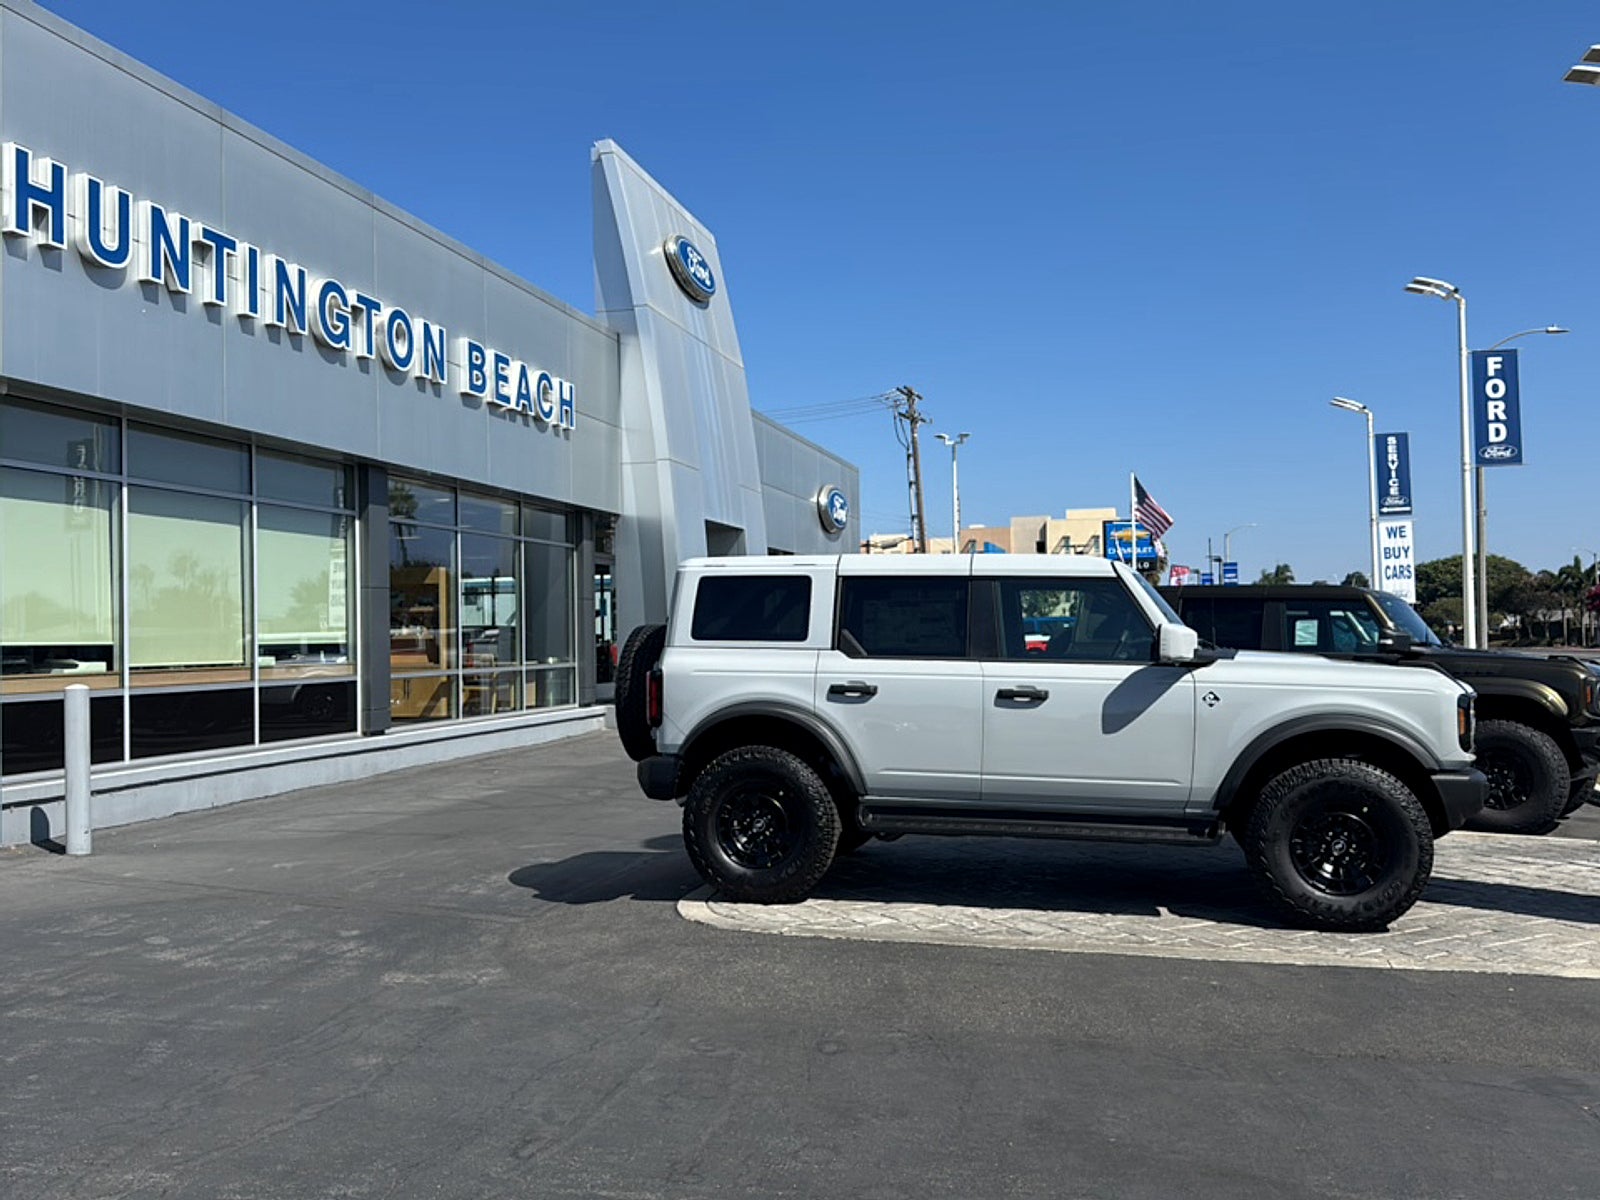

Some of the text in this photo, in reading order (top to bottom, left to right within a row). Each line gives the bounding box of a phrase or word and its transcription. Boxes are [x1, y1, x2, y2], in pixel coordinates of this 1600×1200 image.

[687, 246, 711, 287] Ford
[3, 142, 576, 429] HUNTINGTON BEACH
[1485, 357, 1507, 443] FORD
[1386, 525, 1407, 539] WE
[1384, 546, 1410, 559] BUY
[1385, 564, 1412, 580] CARS
